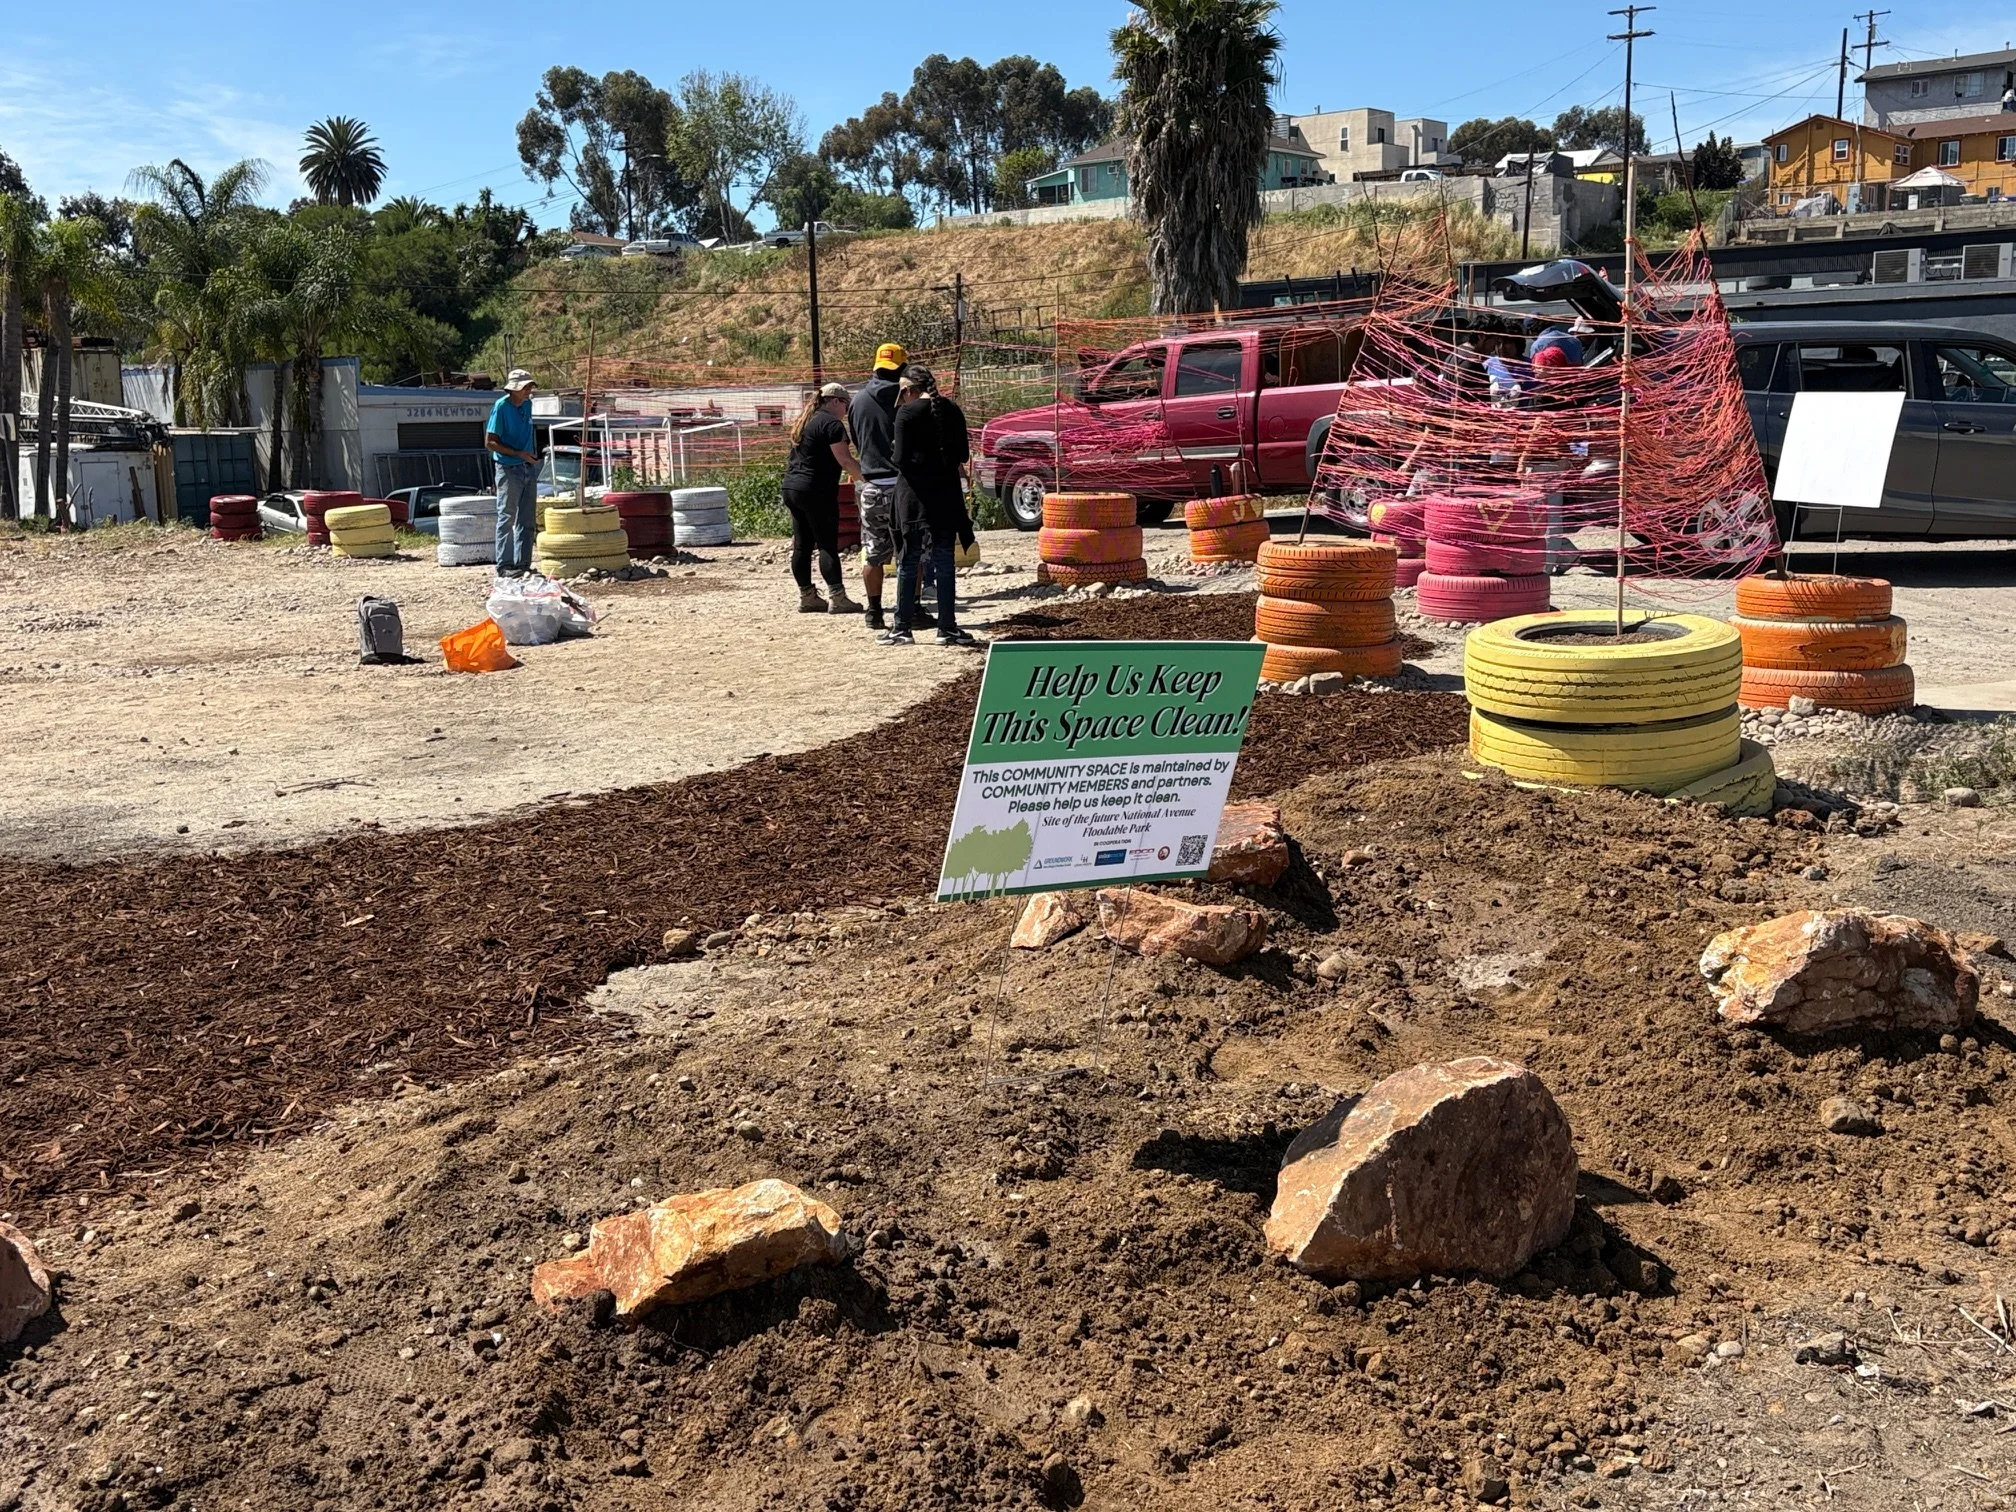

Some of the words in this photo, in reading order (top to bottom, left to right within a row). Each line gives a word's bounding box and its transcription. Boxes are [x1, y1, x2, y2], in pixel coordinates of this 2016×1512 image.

[435, 407, 482, 417] NEWTON
[1023, 664, 1099, 707] Help
[1105, 664, 1144, 696] Us
[1147, 664, 1223, 704] Keep
[981, 709, 1050, 745] This
[1053, 708, 1146, 750] Space
[1150, 705, 1249, 738] Clean!
[972, 768, 1000, 784] This
[1001, 764, 1084, 782] COMMUNITY
[1086, 762, 1128, 776] SPACE
[1129, 761, 1139, 775] is
[1142, 759, 1212, 774] maintained
[1213, 758, 1230, 774] by
[981, 781, 1065, 799] COMMUNITY
[1067, 777, 1129, 794] MEMBERS
[1131, 776, 1156, 790] and
[1157, 774, 1213, 792] partners.
[1008, 799, 1051, 814] Please
[1053, 797, 1081, 812] help
[1083, 798, 1099, 809] us
[1101, 796, 1132, 811] keep
[1133, 792, 1143, 805] it
[1144, 792, 1181, 804] clean.
[1041, 814, 1061, 827] Site
[1062, 814, 1075, 827] of
[1074, 813, 1088, 824] the
[1087, 811, 1120, 826] future
[1122, 807, 1161, 821] National
[1162, 808, 1197, 819] Avenue
[1082, 825, 1128, 838] Floodable
[1129, 822, 1152, 834] Park
